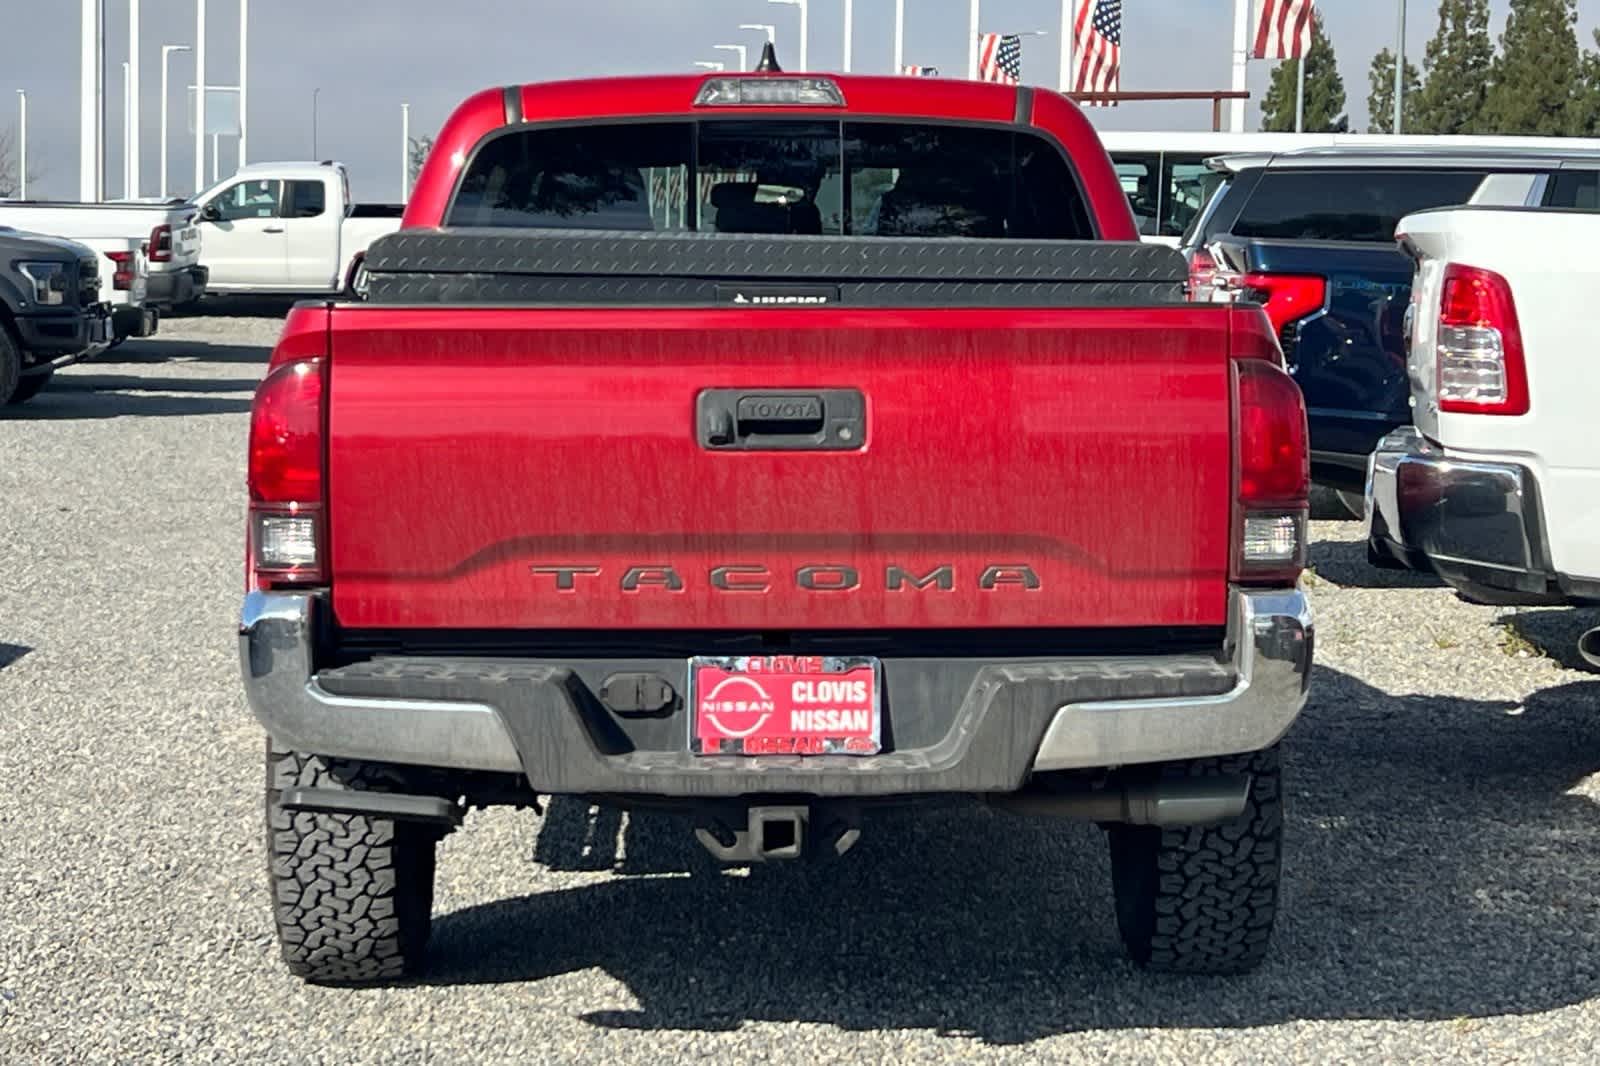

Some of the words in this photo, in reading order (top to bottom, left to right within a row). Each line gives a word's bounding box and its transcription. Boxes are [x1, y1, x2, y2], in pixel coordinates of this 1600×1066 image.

[749, 402, 820, 418] TOYOTA
[529, 564, 1043, 593] TACOMA
[791, 680, 867, 703] CLOVIS
[701, 700, 775, 713] NISSAN
[790, 708, 869, 732] NISSAN
